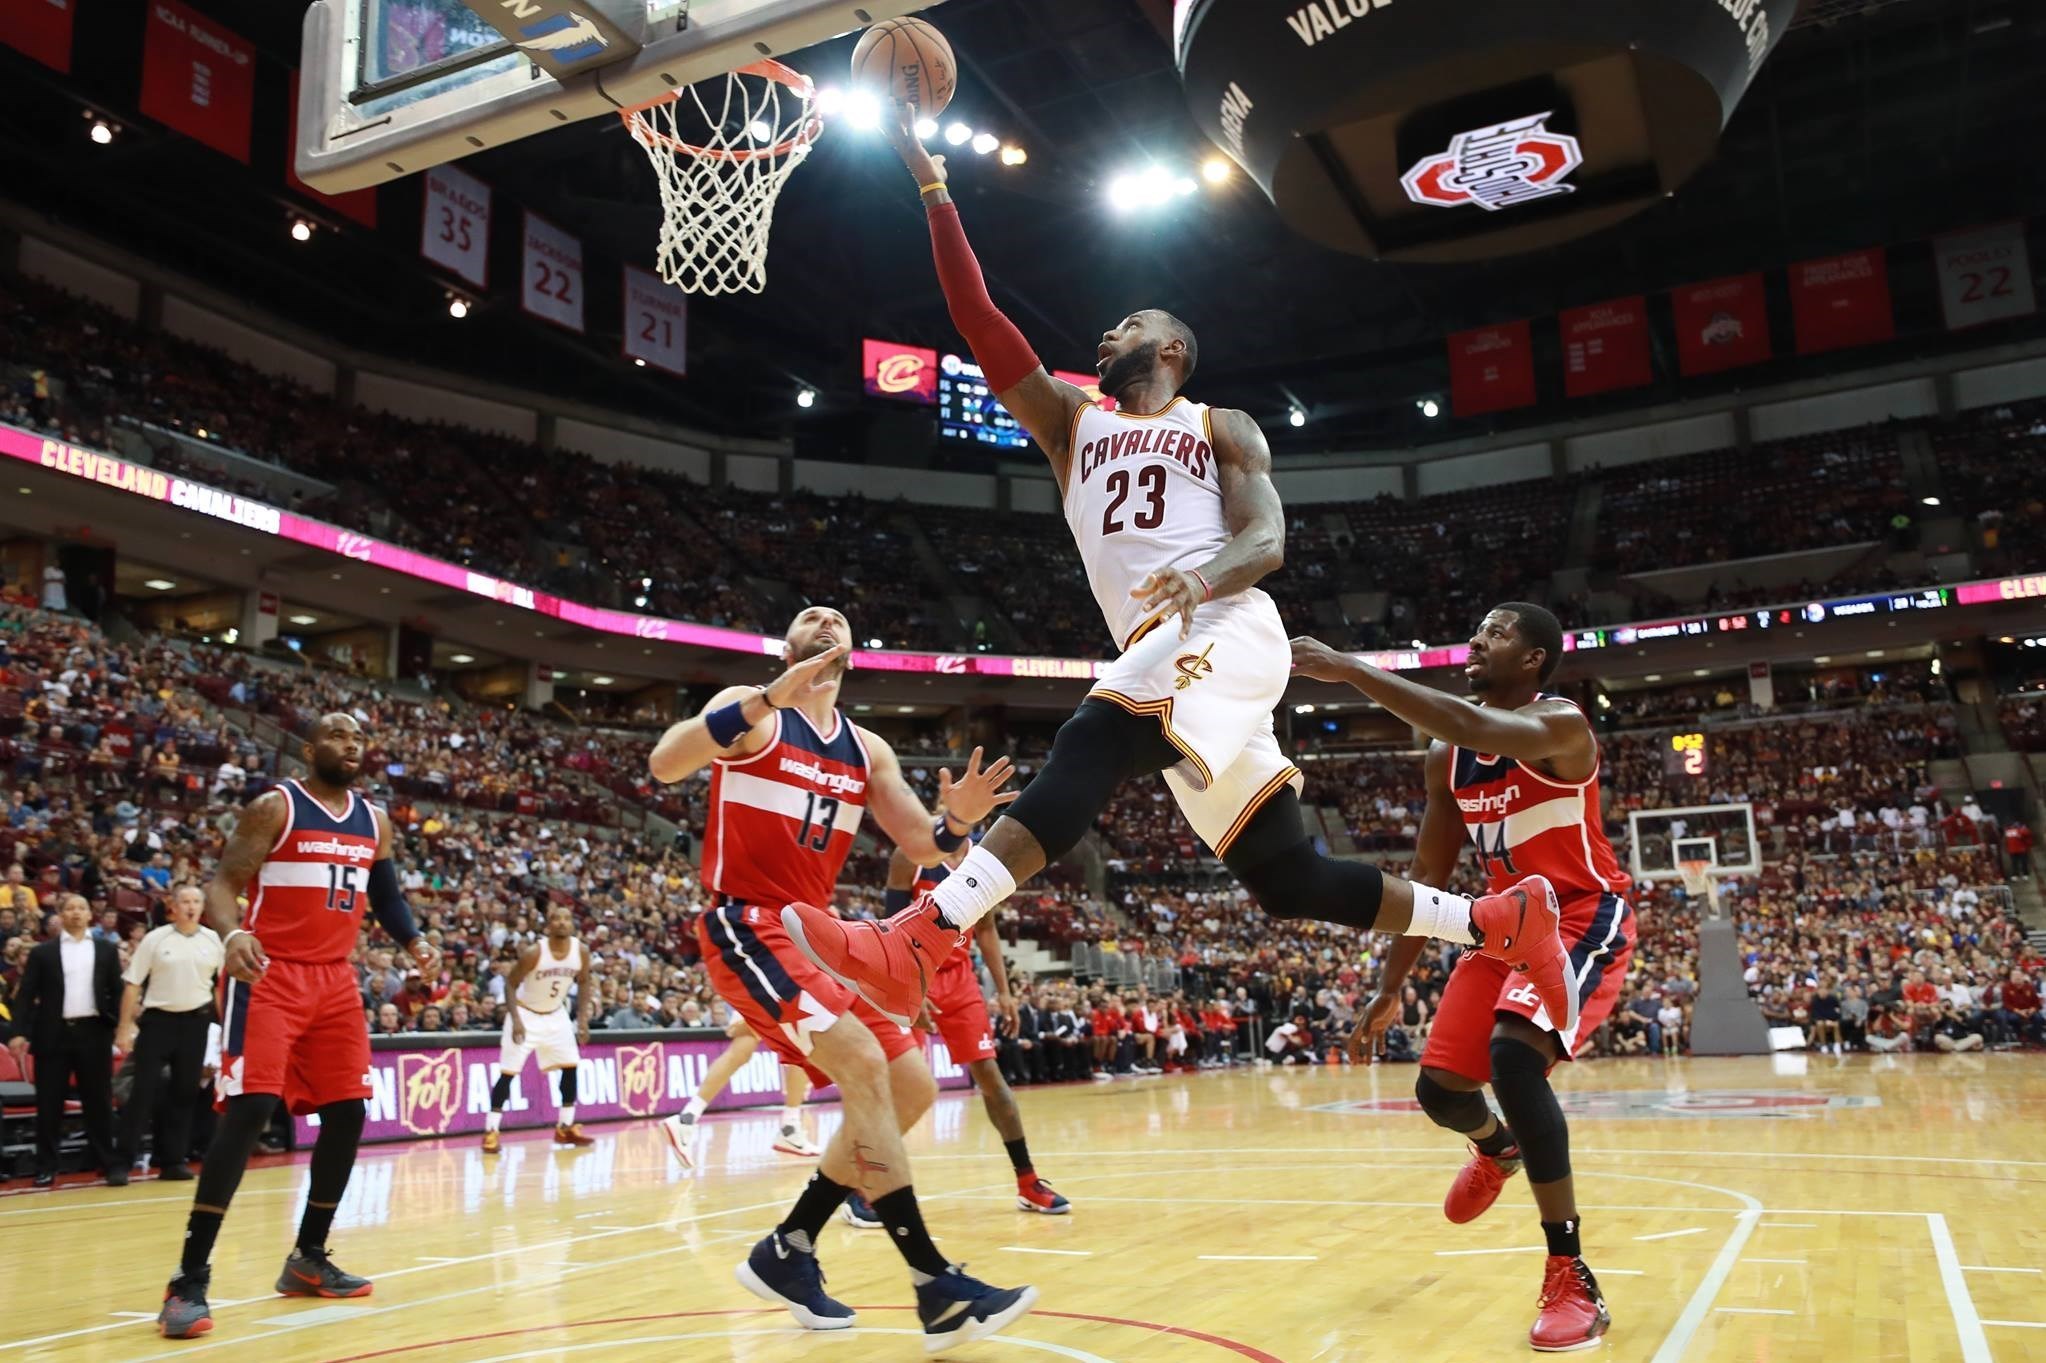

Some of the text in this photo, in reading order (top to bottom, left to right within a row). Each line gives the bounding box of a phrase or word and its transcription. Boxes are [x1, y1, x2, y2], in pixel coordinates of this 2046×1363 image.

[1286, 0, 1392, 47] VALU
[440, 206, 472, 252] 35
[534, 261, 573, 305] 22
[1958, 264, 2015, 304] 22
[640, 311, 673, 349] 21
[41, 439, 168, 501] CLEVELAND
[1081, 428, 1211, 485] CAVALIERS
[1102, 464, 1168, 537] 23
[1012, 658, 1092, 679] CLEVELAND
[778, 757, 865, 794] washington
[1685, 748, 1703, 775] 2
[797, 790, 840, 853] 13
[297, 837, 375, 863] washington
[326, 863, 358, 912] 15
[549, 981, 561, 998] 5
